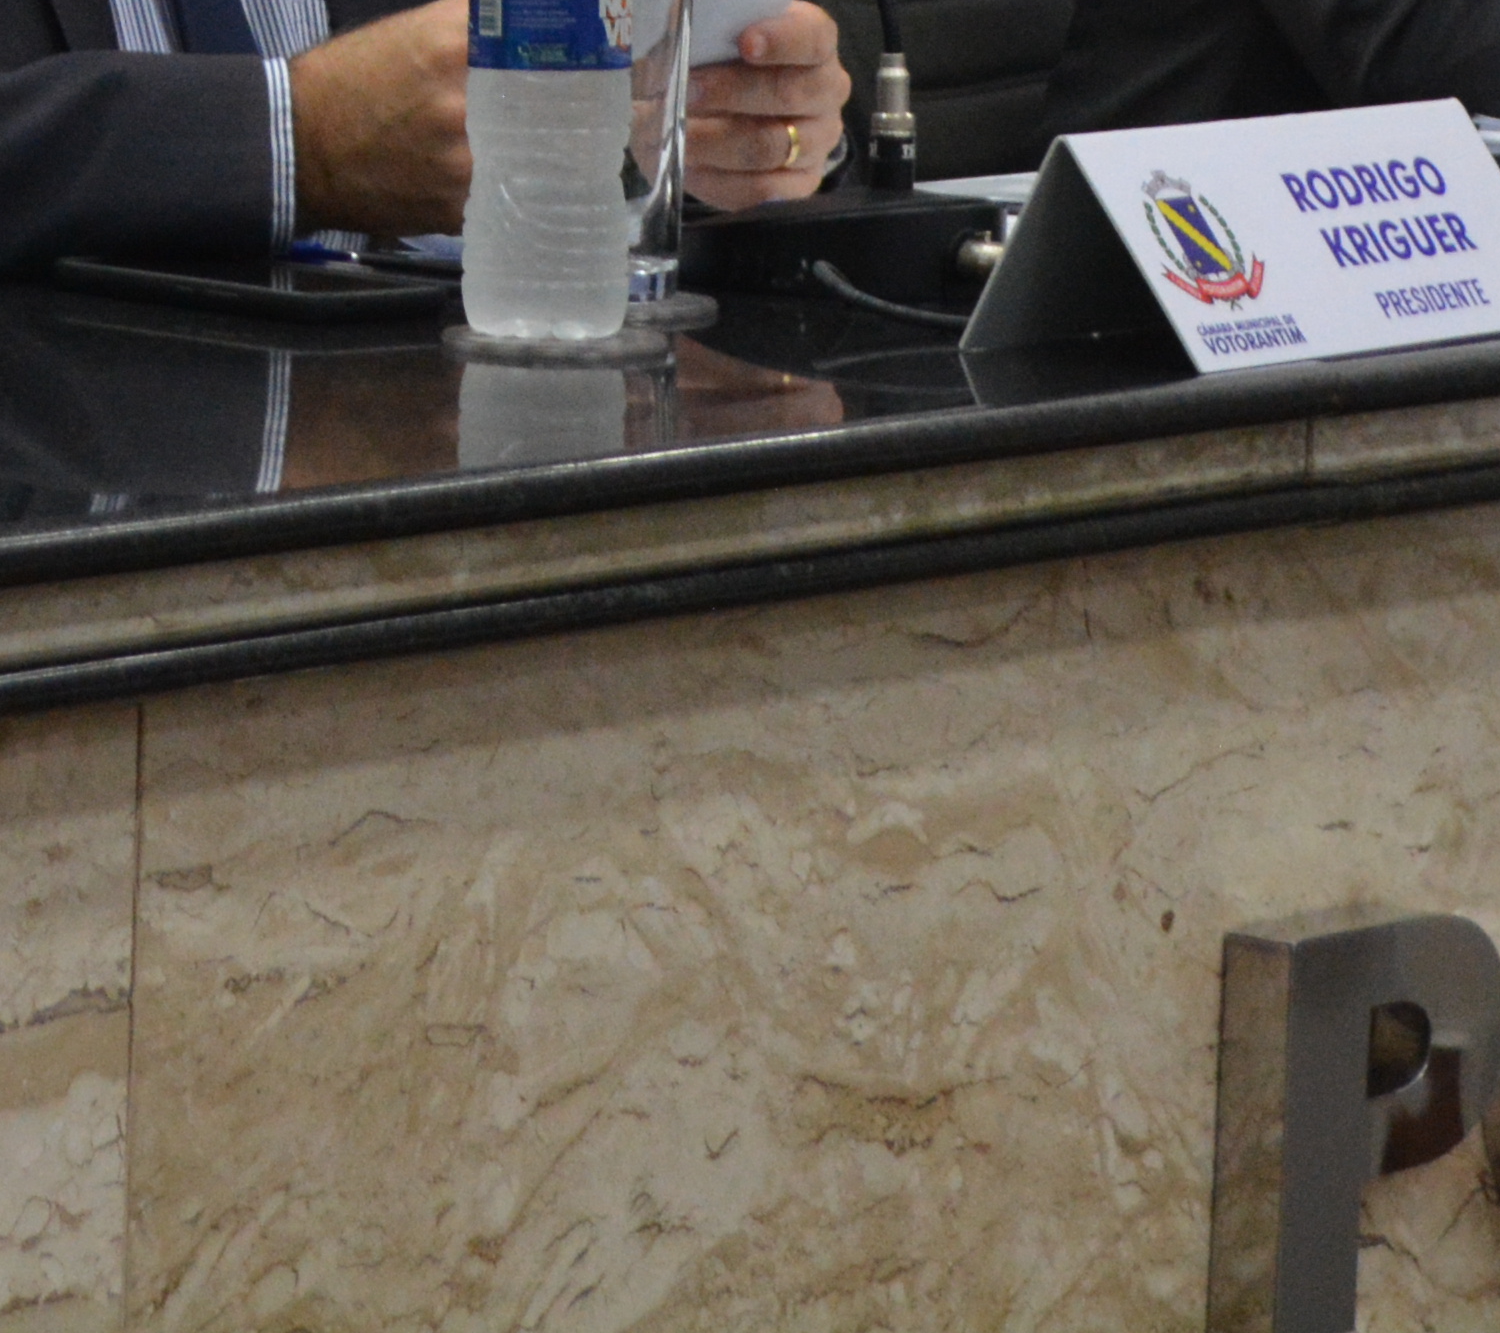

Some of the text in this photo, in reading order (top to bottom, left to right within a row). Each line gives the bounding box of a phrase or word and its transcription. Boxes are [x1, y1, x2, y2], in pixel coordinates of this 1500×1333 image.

[1279, 155, 1446, 212] RODRIGO
[1319, 211, 1479, 269] KRIGUER
[1374, 277, 1492, 319] PRESIDENTE
[1202, 326, 1307, 356] VOTORANTIM
